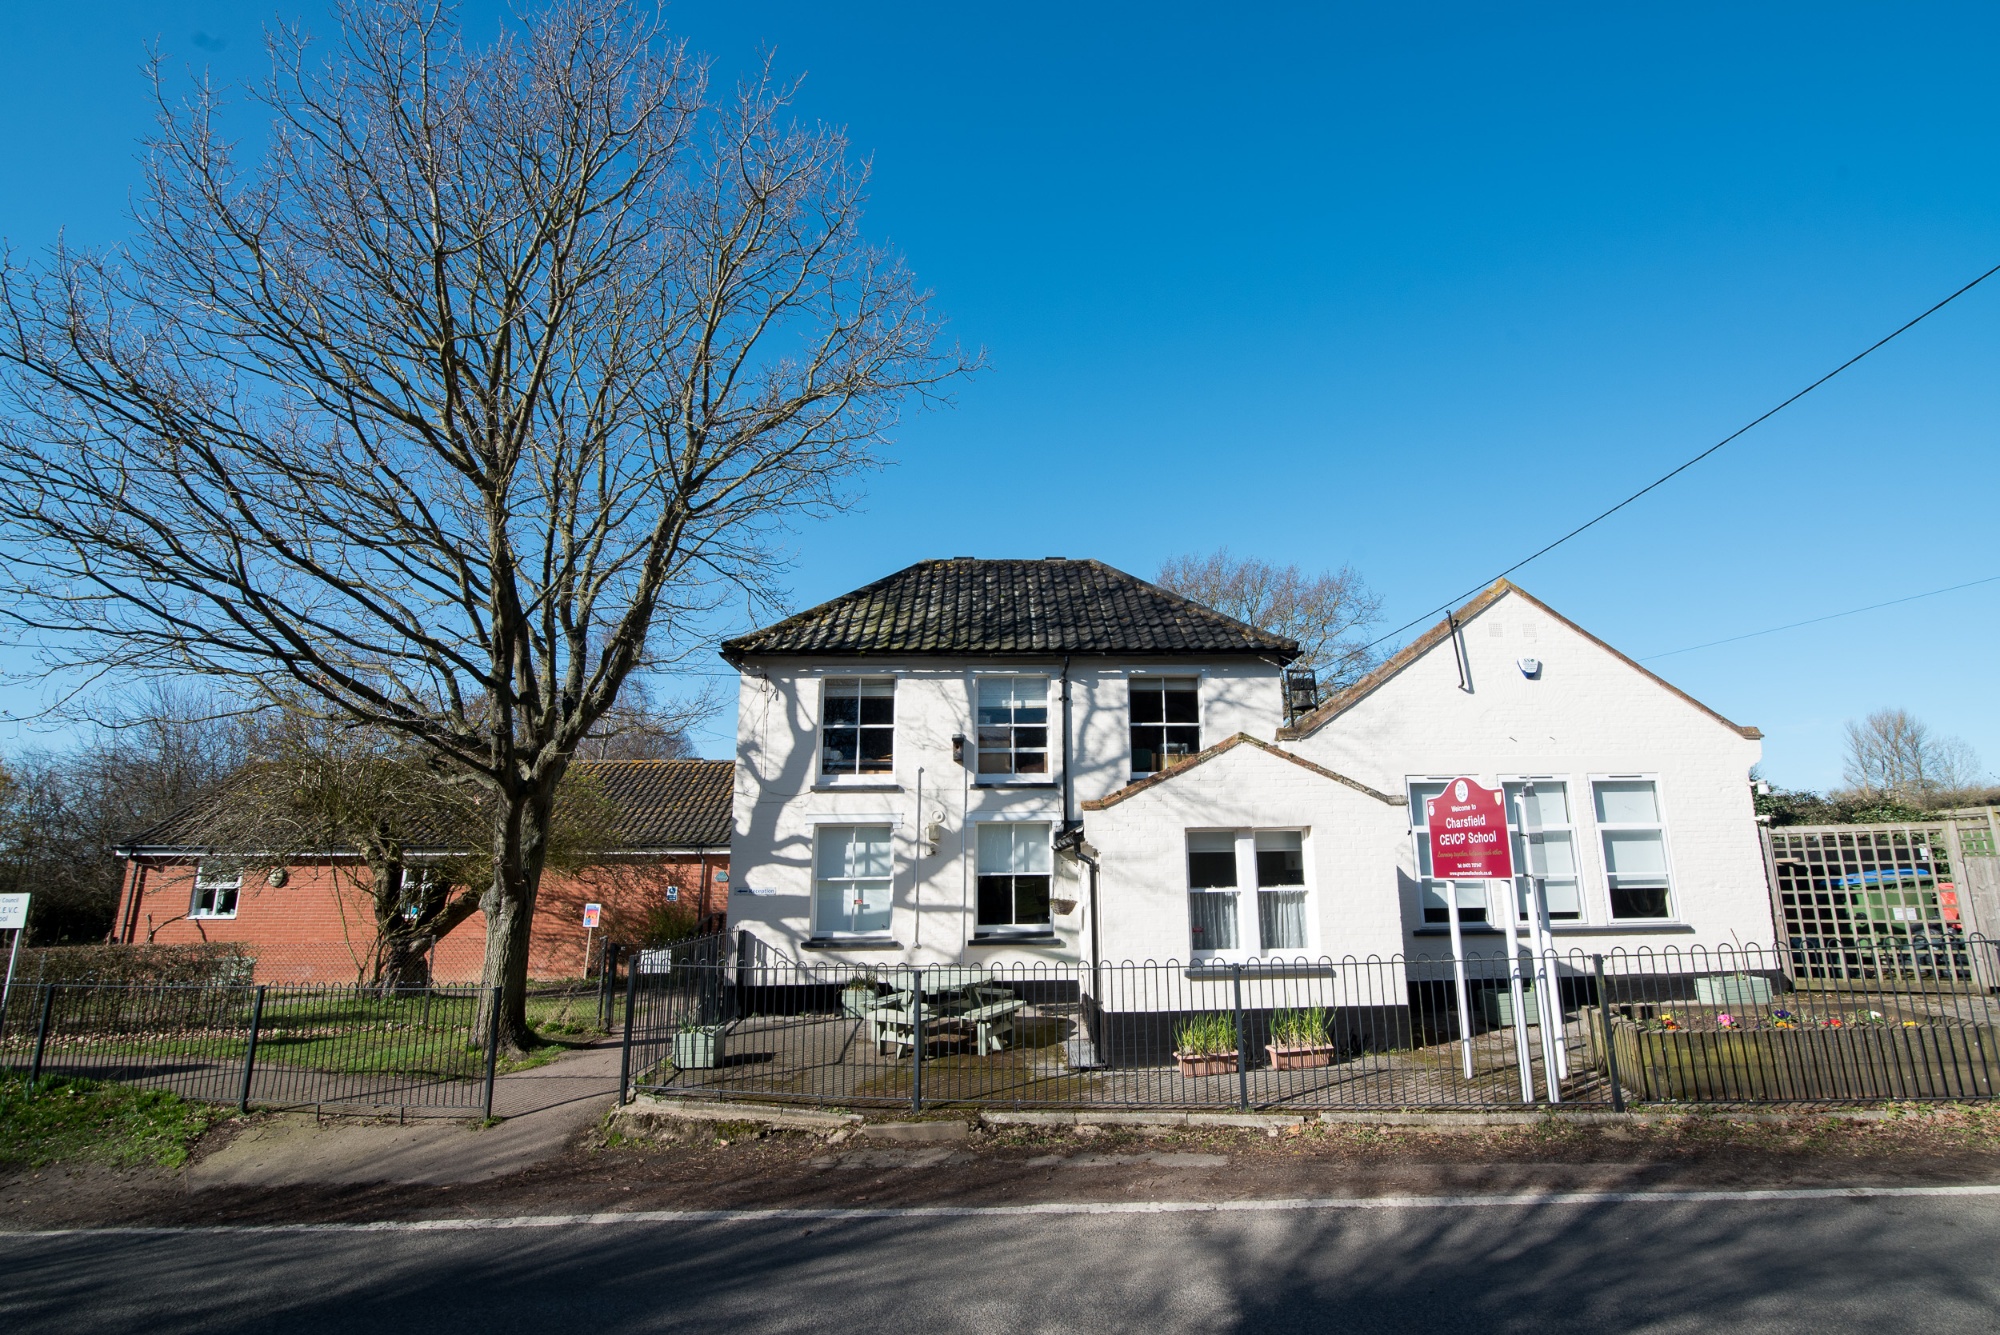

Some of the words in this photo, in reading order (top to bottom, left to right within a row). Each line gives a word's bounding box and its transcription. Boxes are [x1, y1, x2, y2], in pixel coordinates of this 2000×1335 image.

[1446, 814, 1486, 828] Charsfield
[1440, 833, 1465, 845] CEVCP
[1468, 830, 1496, 843] School
